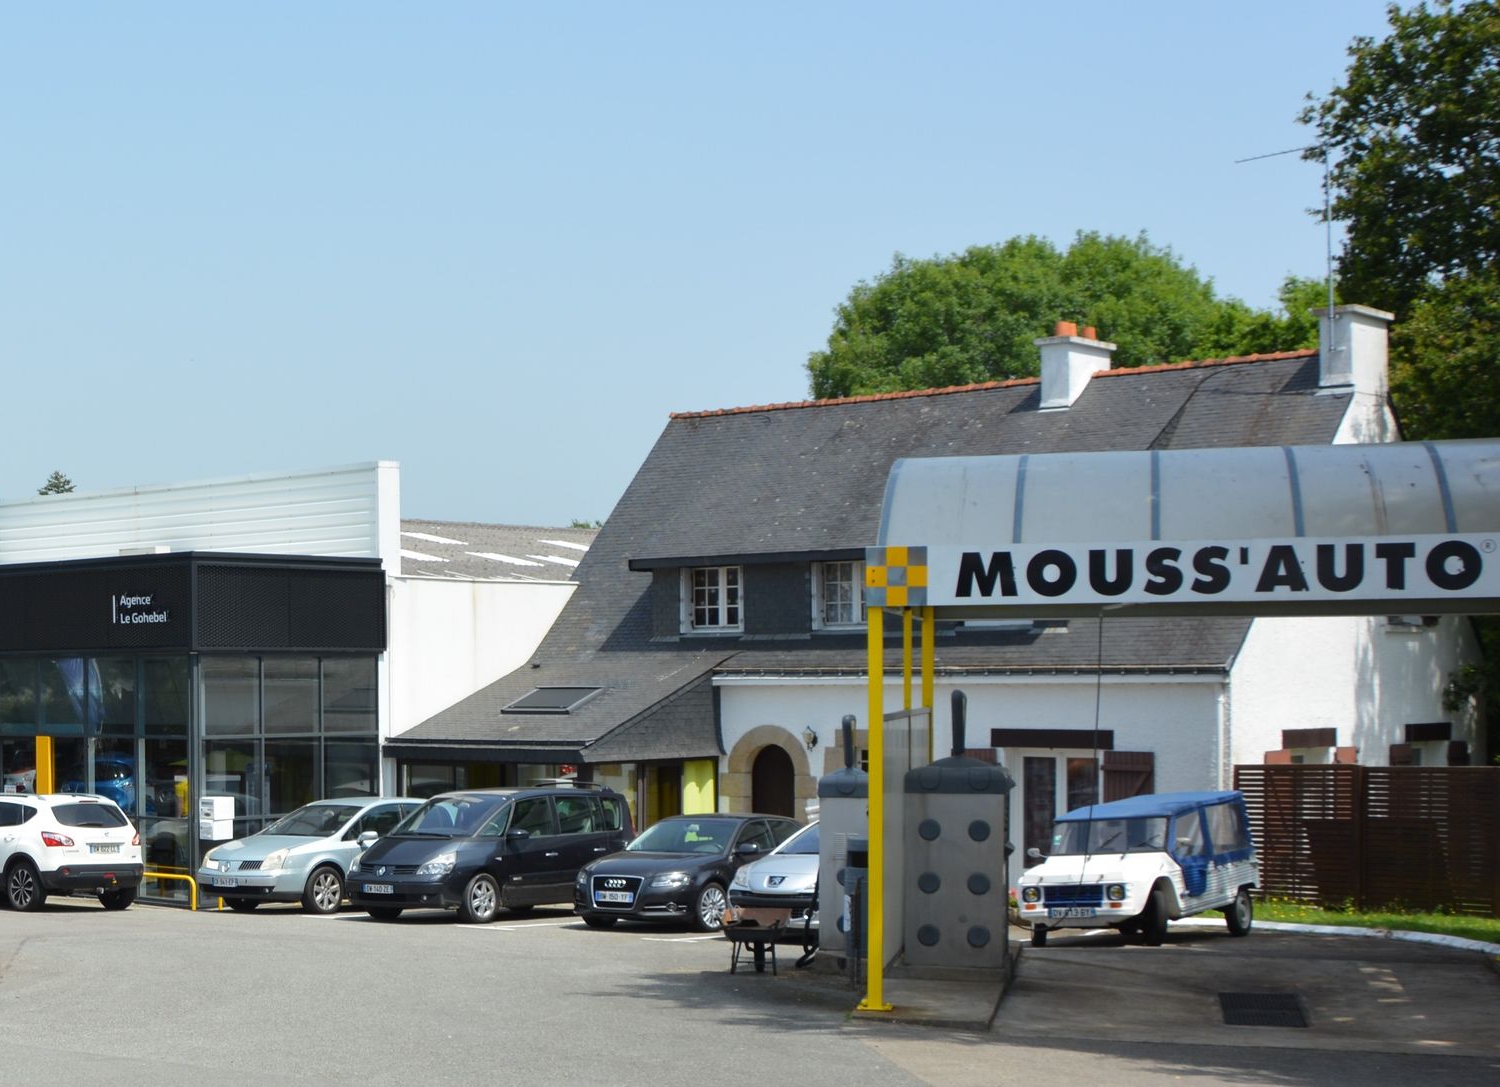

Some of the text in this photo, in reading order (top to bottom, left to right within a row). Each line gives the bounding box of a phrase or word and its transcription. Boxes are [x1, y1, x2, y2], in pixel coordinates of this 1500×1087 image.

[955, 540, 1483, 598] MOUSS'AUTO
[120, 595, 151, 609] Agence
[120, 611, 167, 624] Le Gohebel
